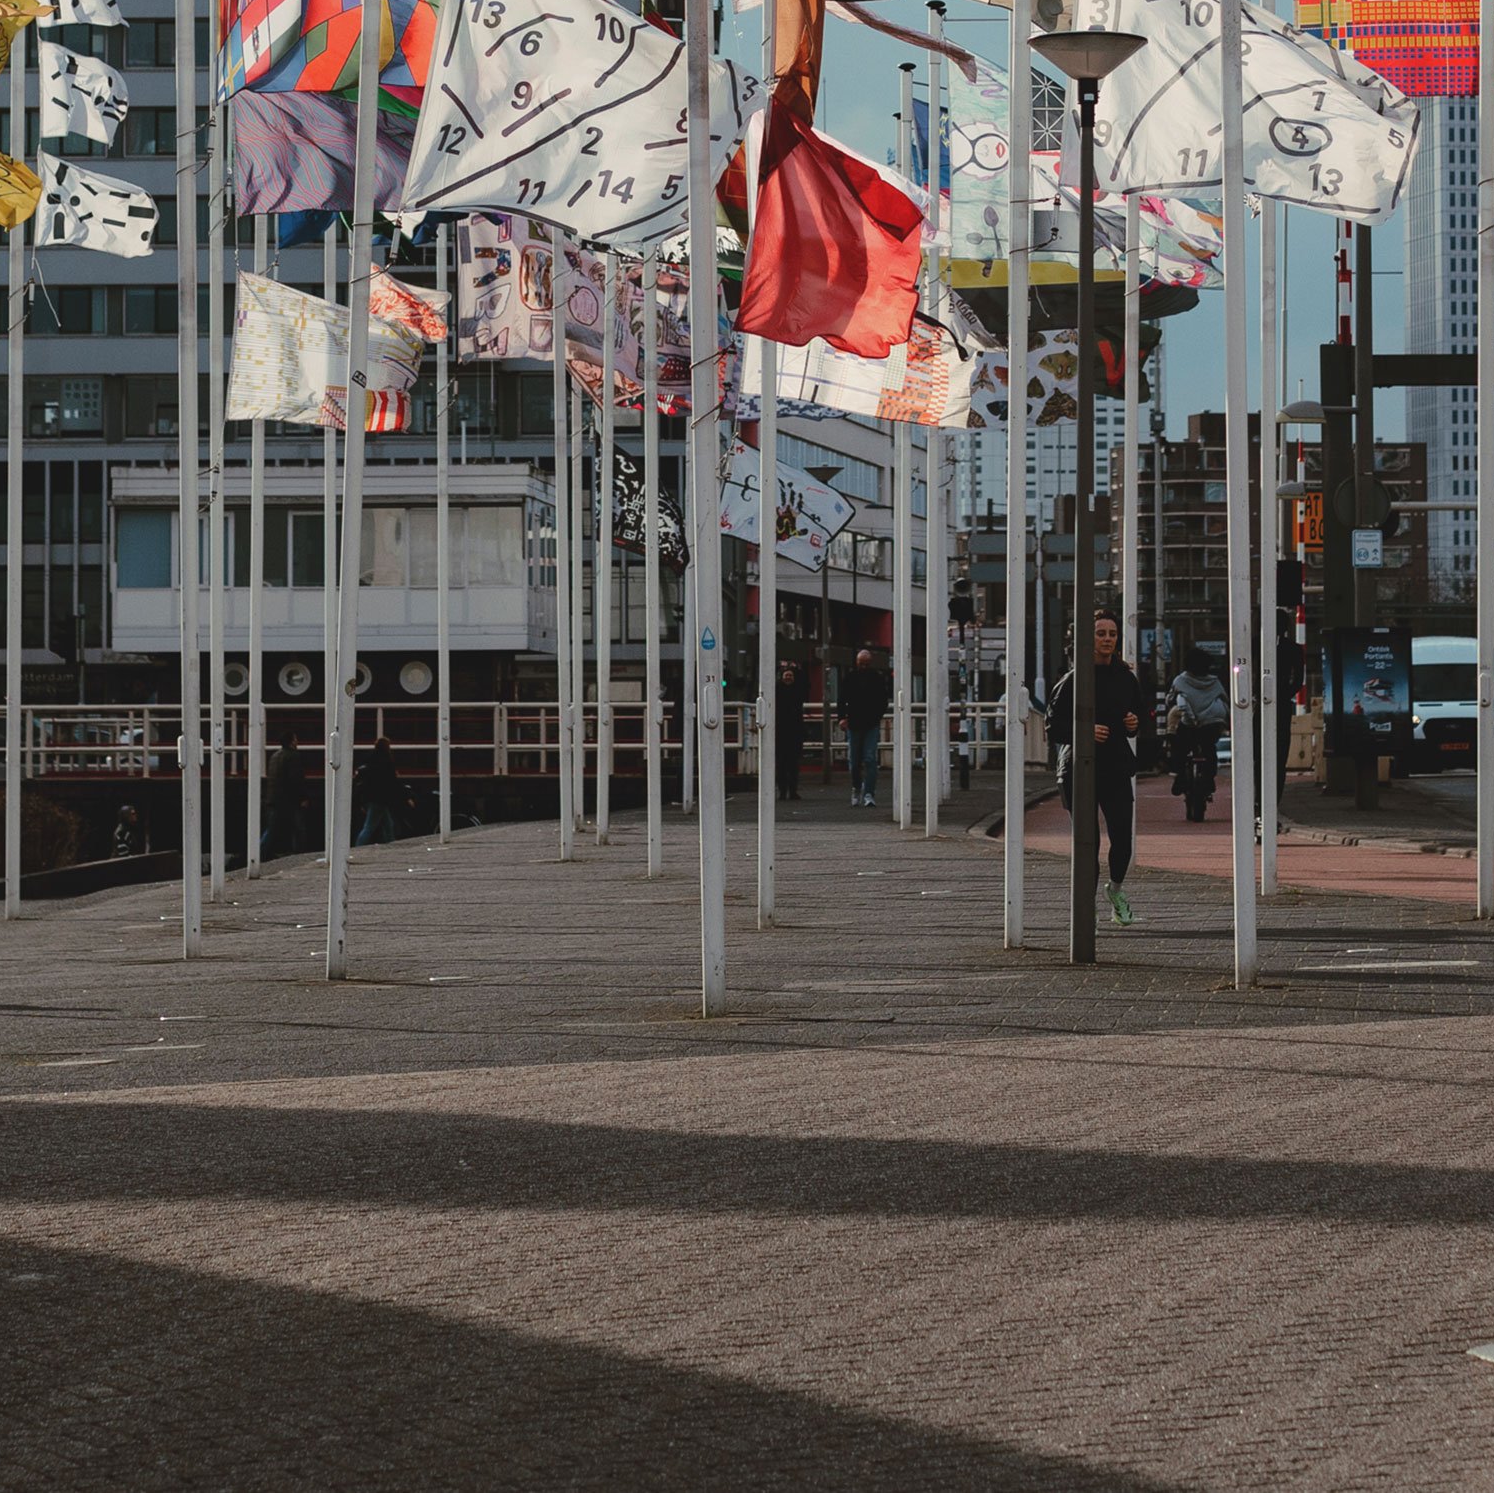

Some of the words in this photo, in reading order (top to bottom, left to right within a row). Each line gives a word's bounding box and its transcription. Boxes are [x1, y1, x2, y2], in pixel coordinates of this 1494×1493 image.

[594, 13, 625, 43] 10
[520, 31, 543, 56] 6
[511, 81, 533, 110] 9
[742, 76, 759, 101] 3
[437, 124, 467, 155] 12
[580, 127, 603, 156] 2
[1094, 120, 1112, 147] 9
[1291, 126, 1309, 149] 4
[1387, 128, 1405, 149] 5
[1178, 148, 1208, 177] 11
[517, 178, 546, 205] 11
[598, 170, 635, 204] 14
[661, 174, 684, 200] 5
[1308, 163, 1343, 196] 13
[705, 674, 715, 683] 31
[1374, 661, 1385, 669] 22
